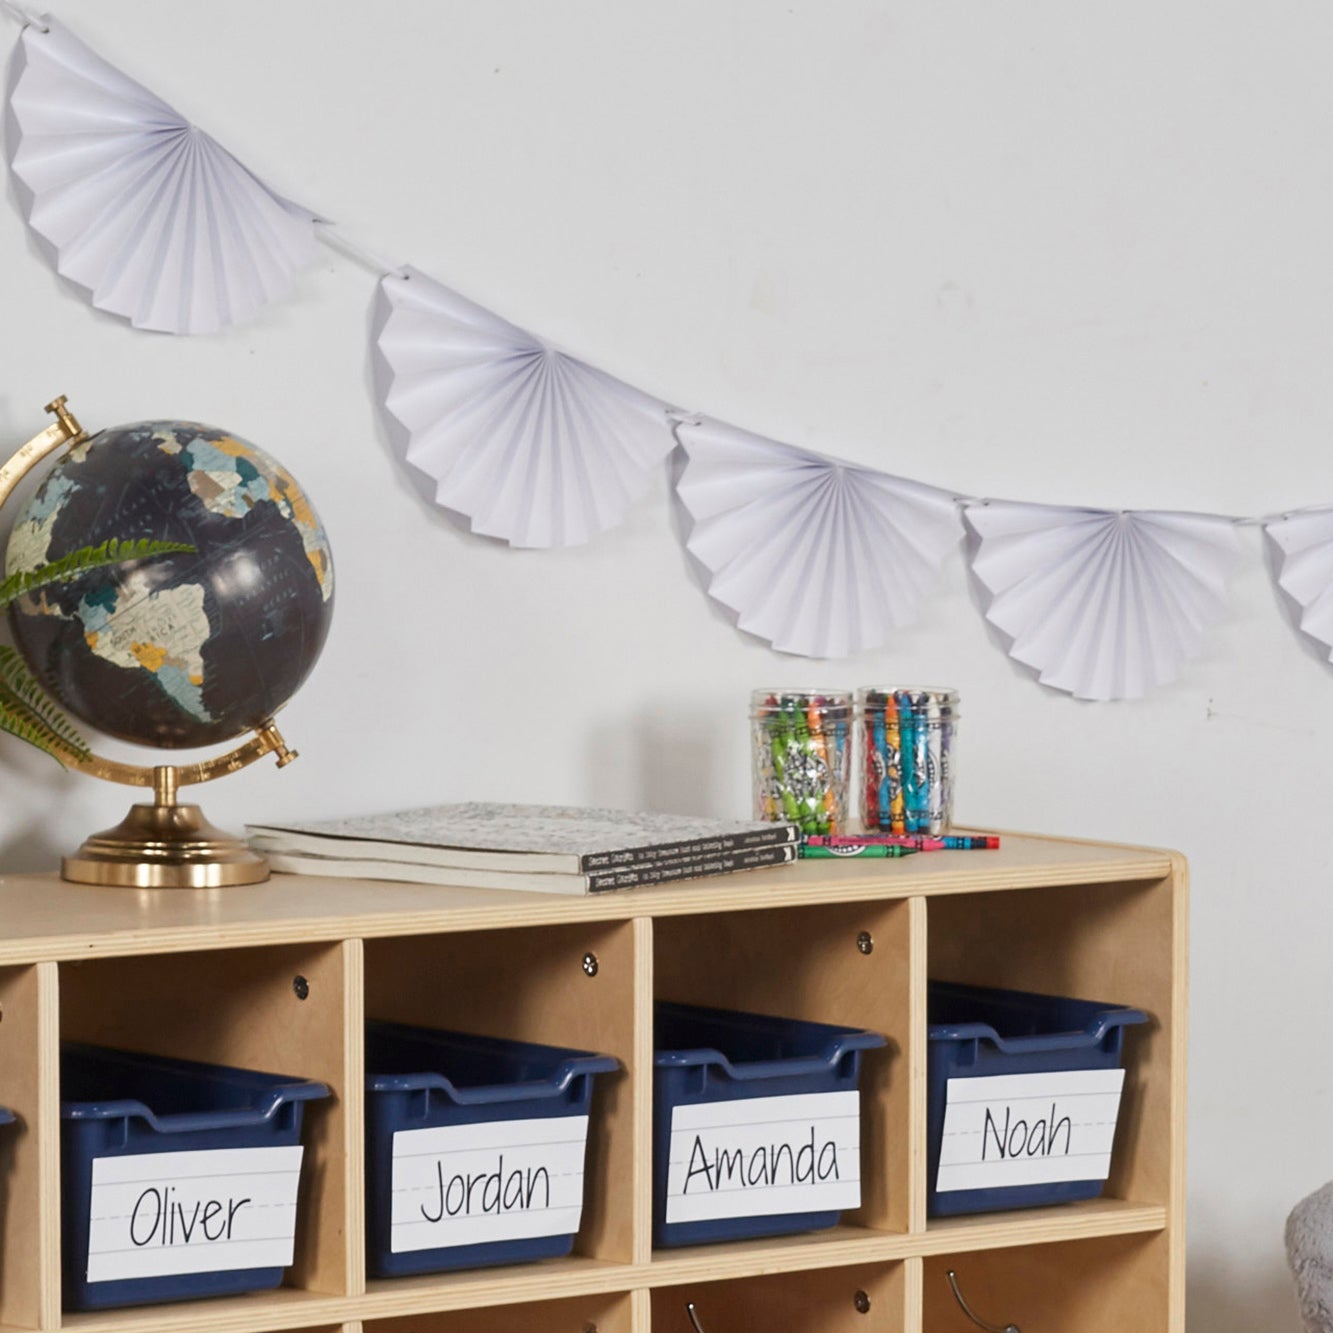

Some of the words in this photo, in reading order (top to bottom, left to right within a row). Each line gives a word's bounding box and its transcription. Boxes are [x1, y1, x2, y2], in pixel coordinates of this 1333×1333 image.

[684, 1127, 837, 1194] Amanda
[983, 1107, 1071, 1160] Noah
[130, 1187, 251, 1246] Oliver
[422, 1155, 550, 1223] Jordan
